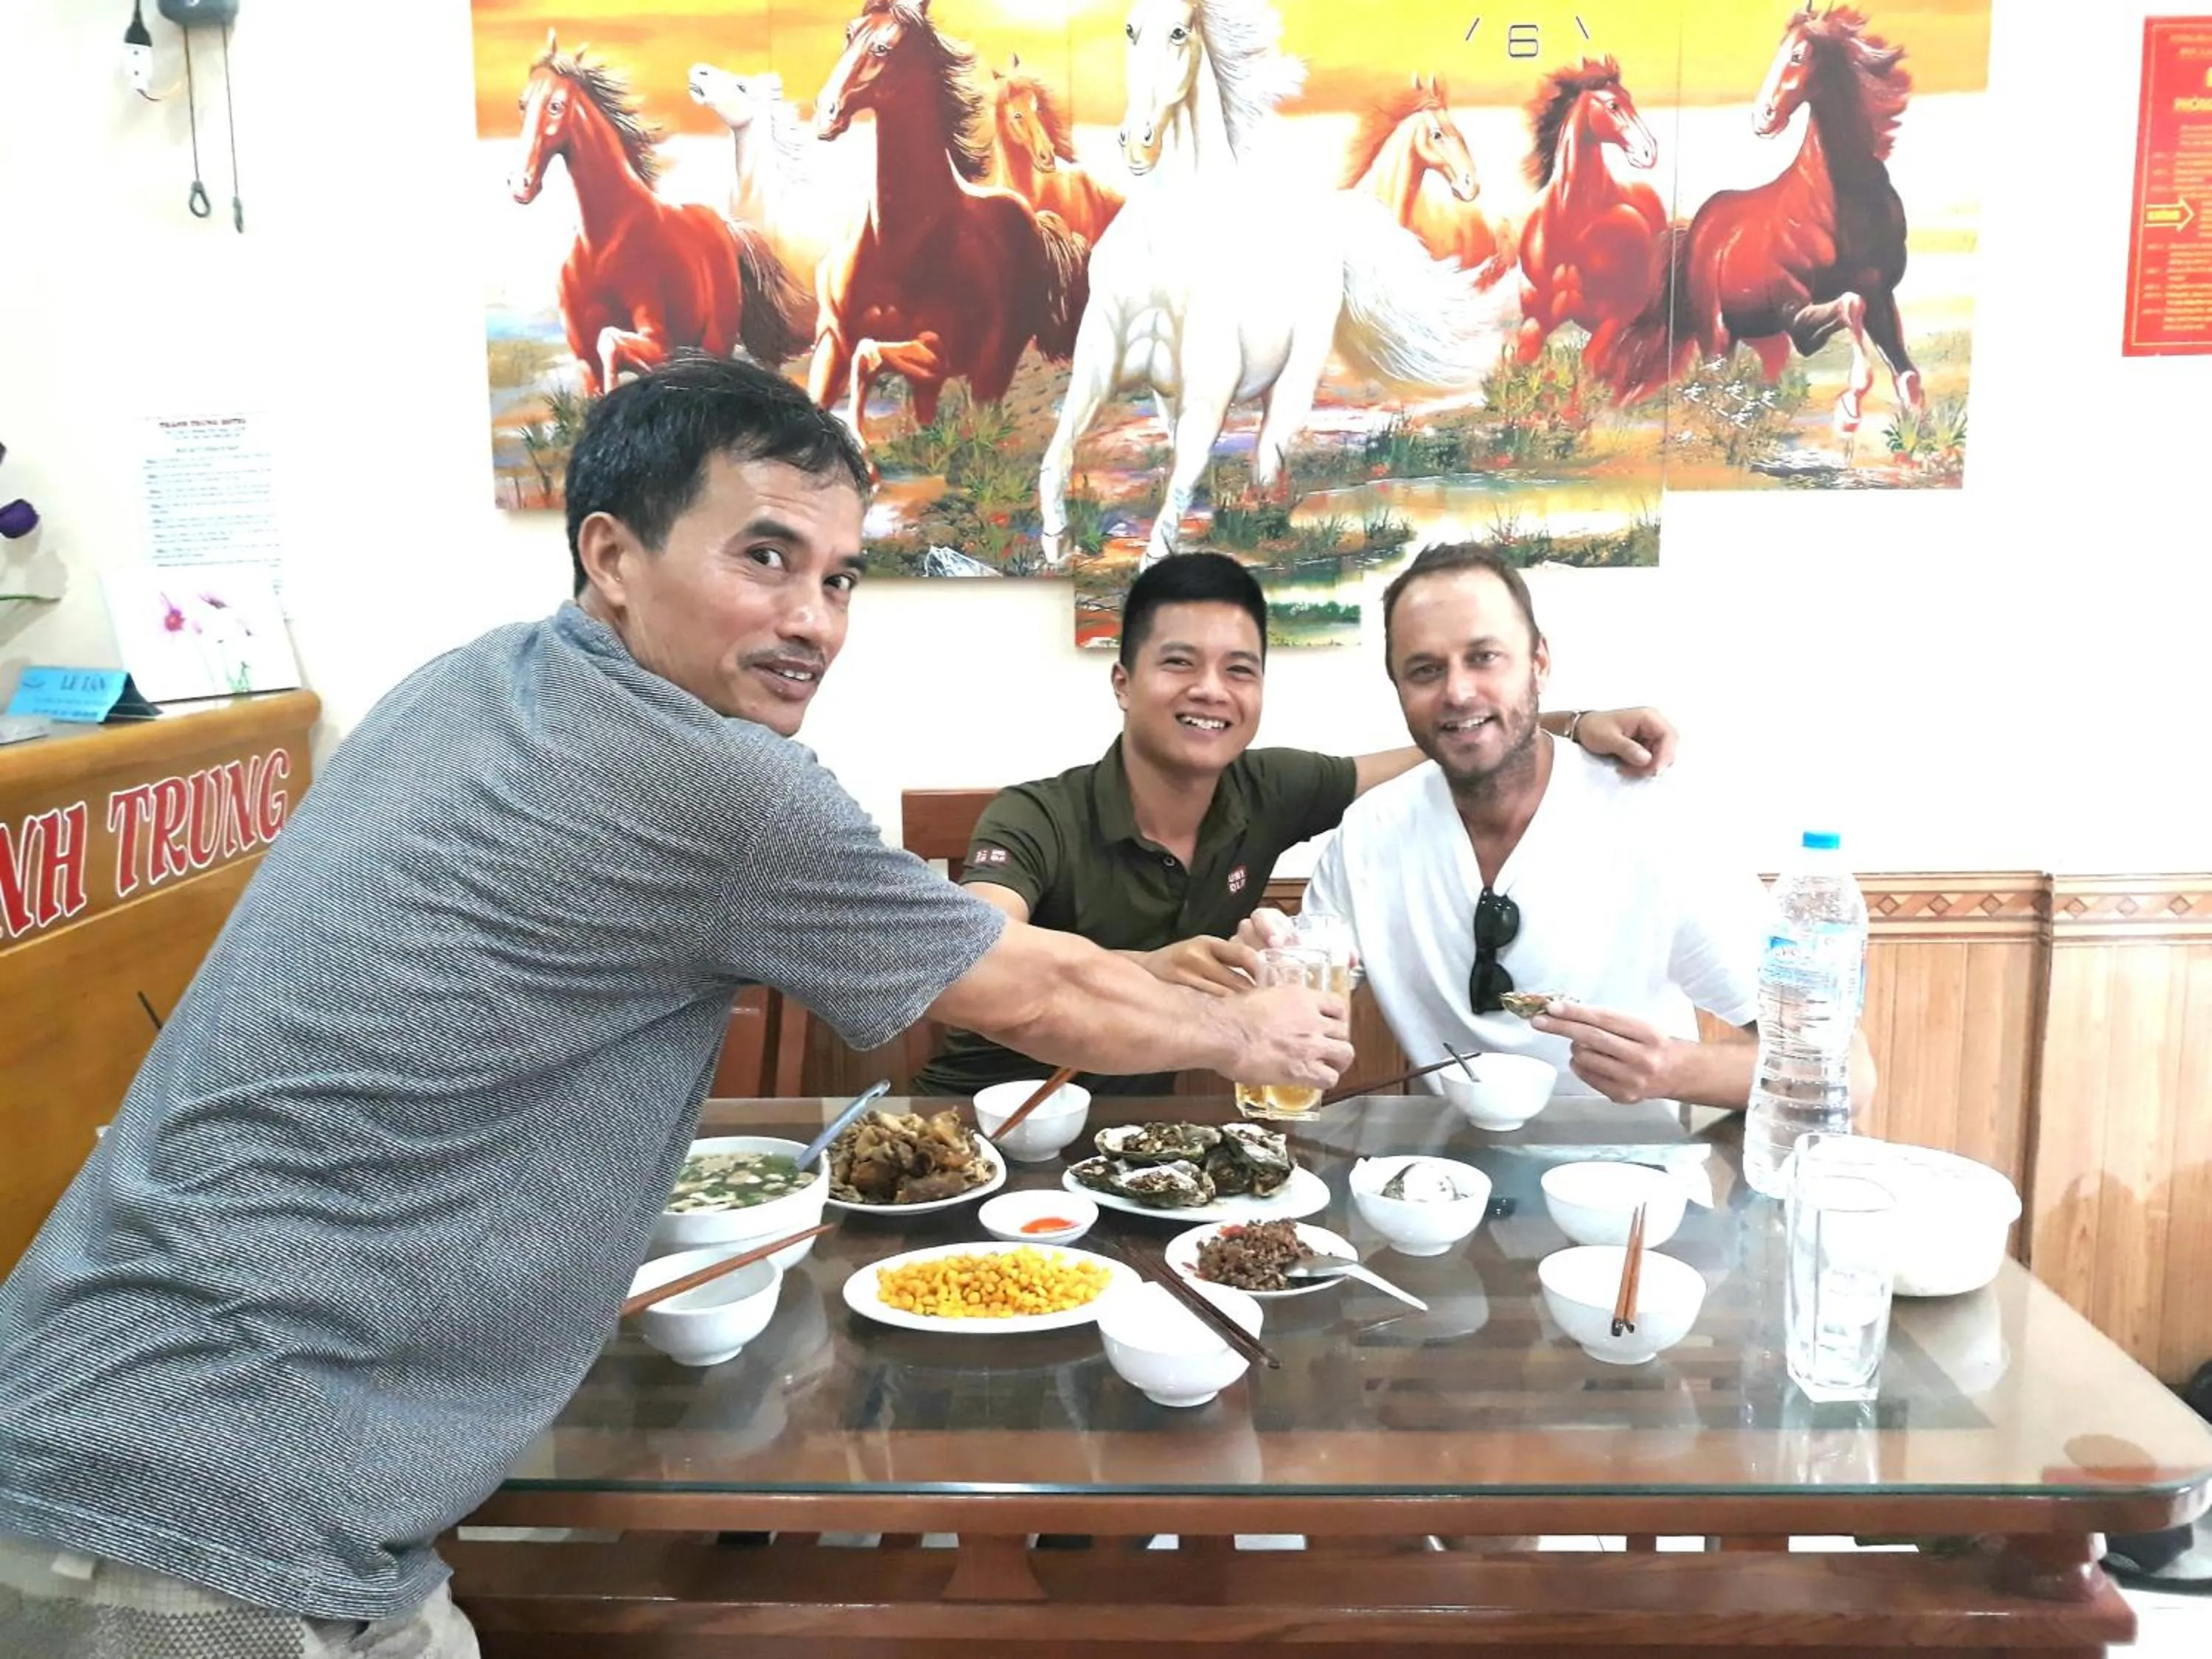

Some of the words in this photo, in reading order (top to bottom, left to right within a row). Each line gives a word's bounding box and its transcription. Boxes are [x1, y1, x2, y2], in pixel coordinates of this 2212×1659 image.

[1508, 24, 1540, 58] 6
[0, 801, 88, 938] NH
[107, 748, 291, 898] TRUNG
